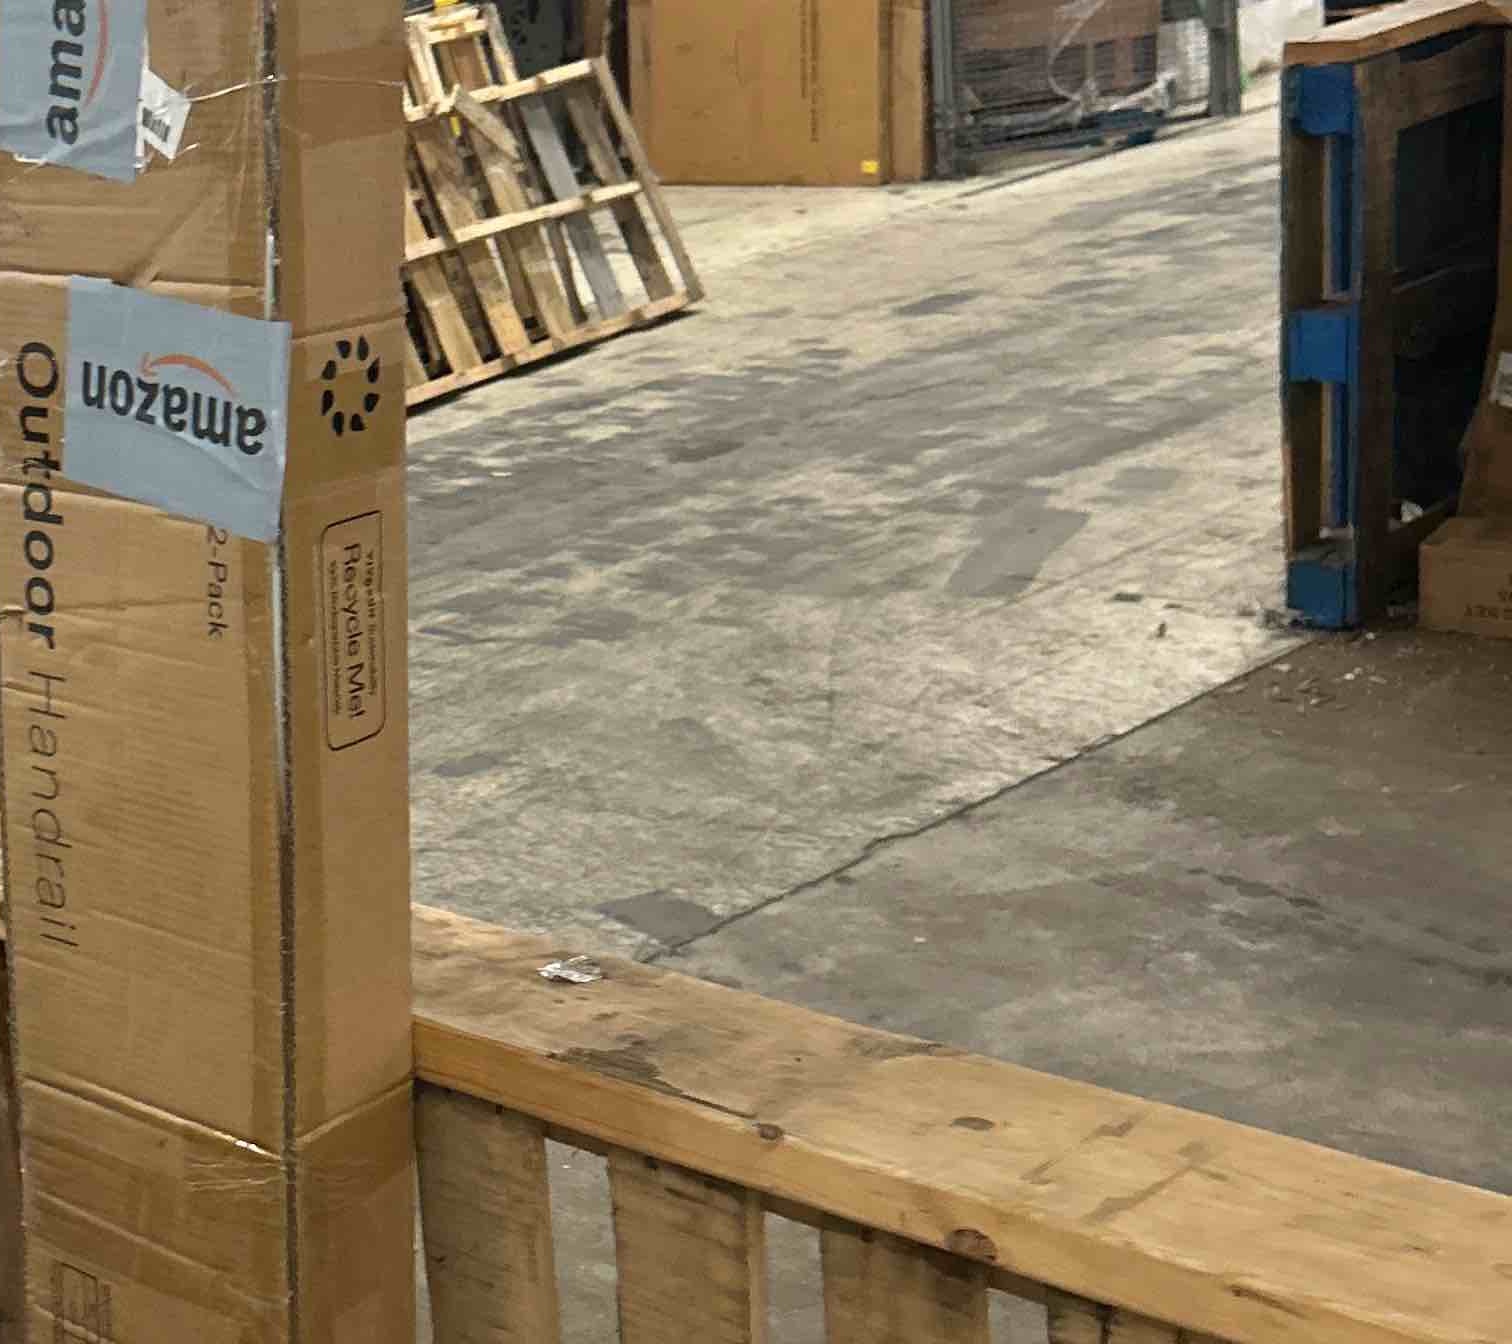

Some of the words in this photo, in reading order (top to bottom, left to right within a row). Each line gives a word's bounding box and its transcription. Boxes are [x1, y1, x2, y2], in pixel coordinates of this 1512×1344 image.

[81, 358, 267, 456] amazon
[16, 343, 65, 652] Outdoor
[205, 528, 228, 639] 2-Pack
[342, 542, 363, 657] Recycle
[347, 661, 367, 719] Me!
[26, 672, 78, 949] Handrail
